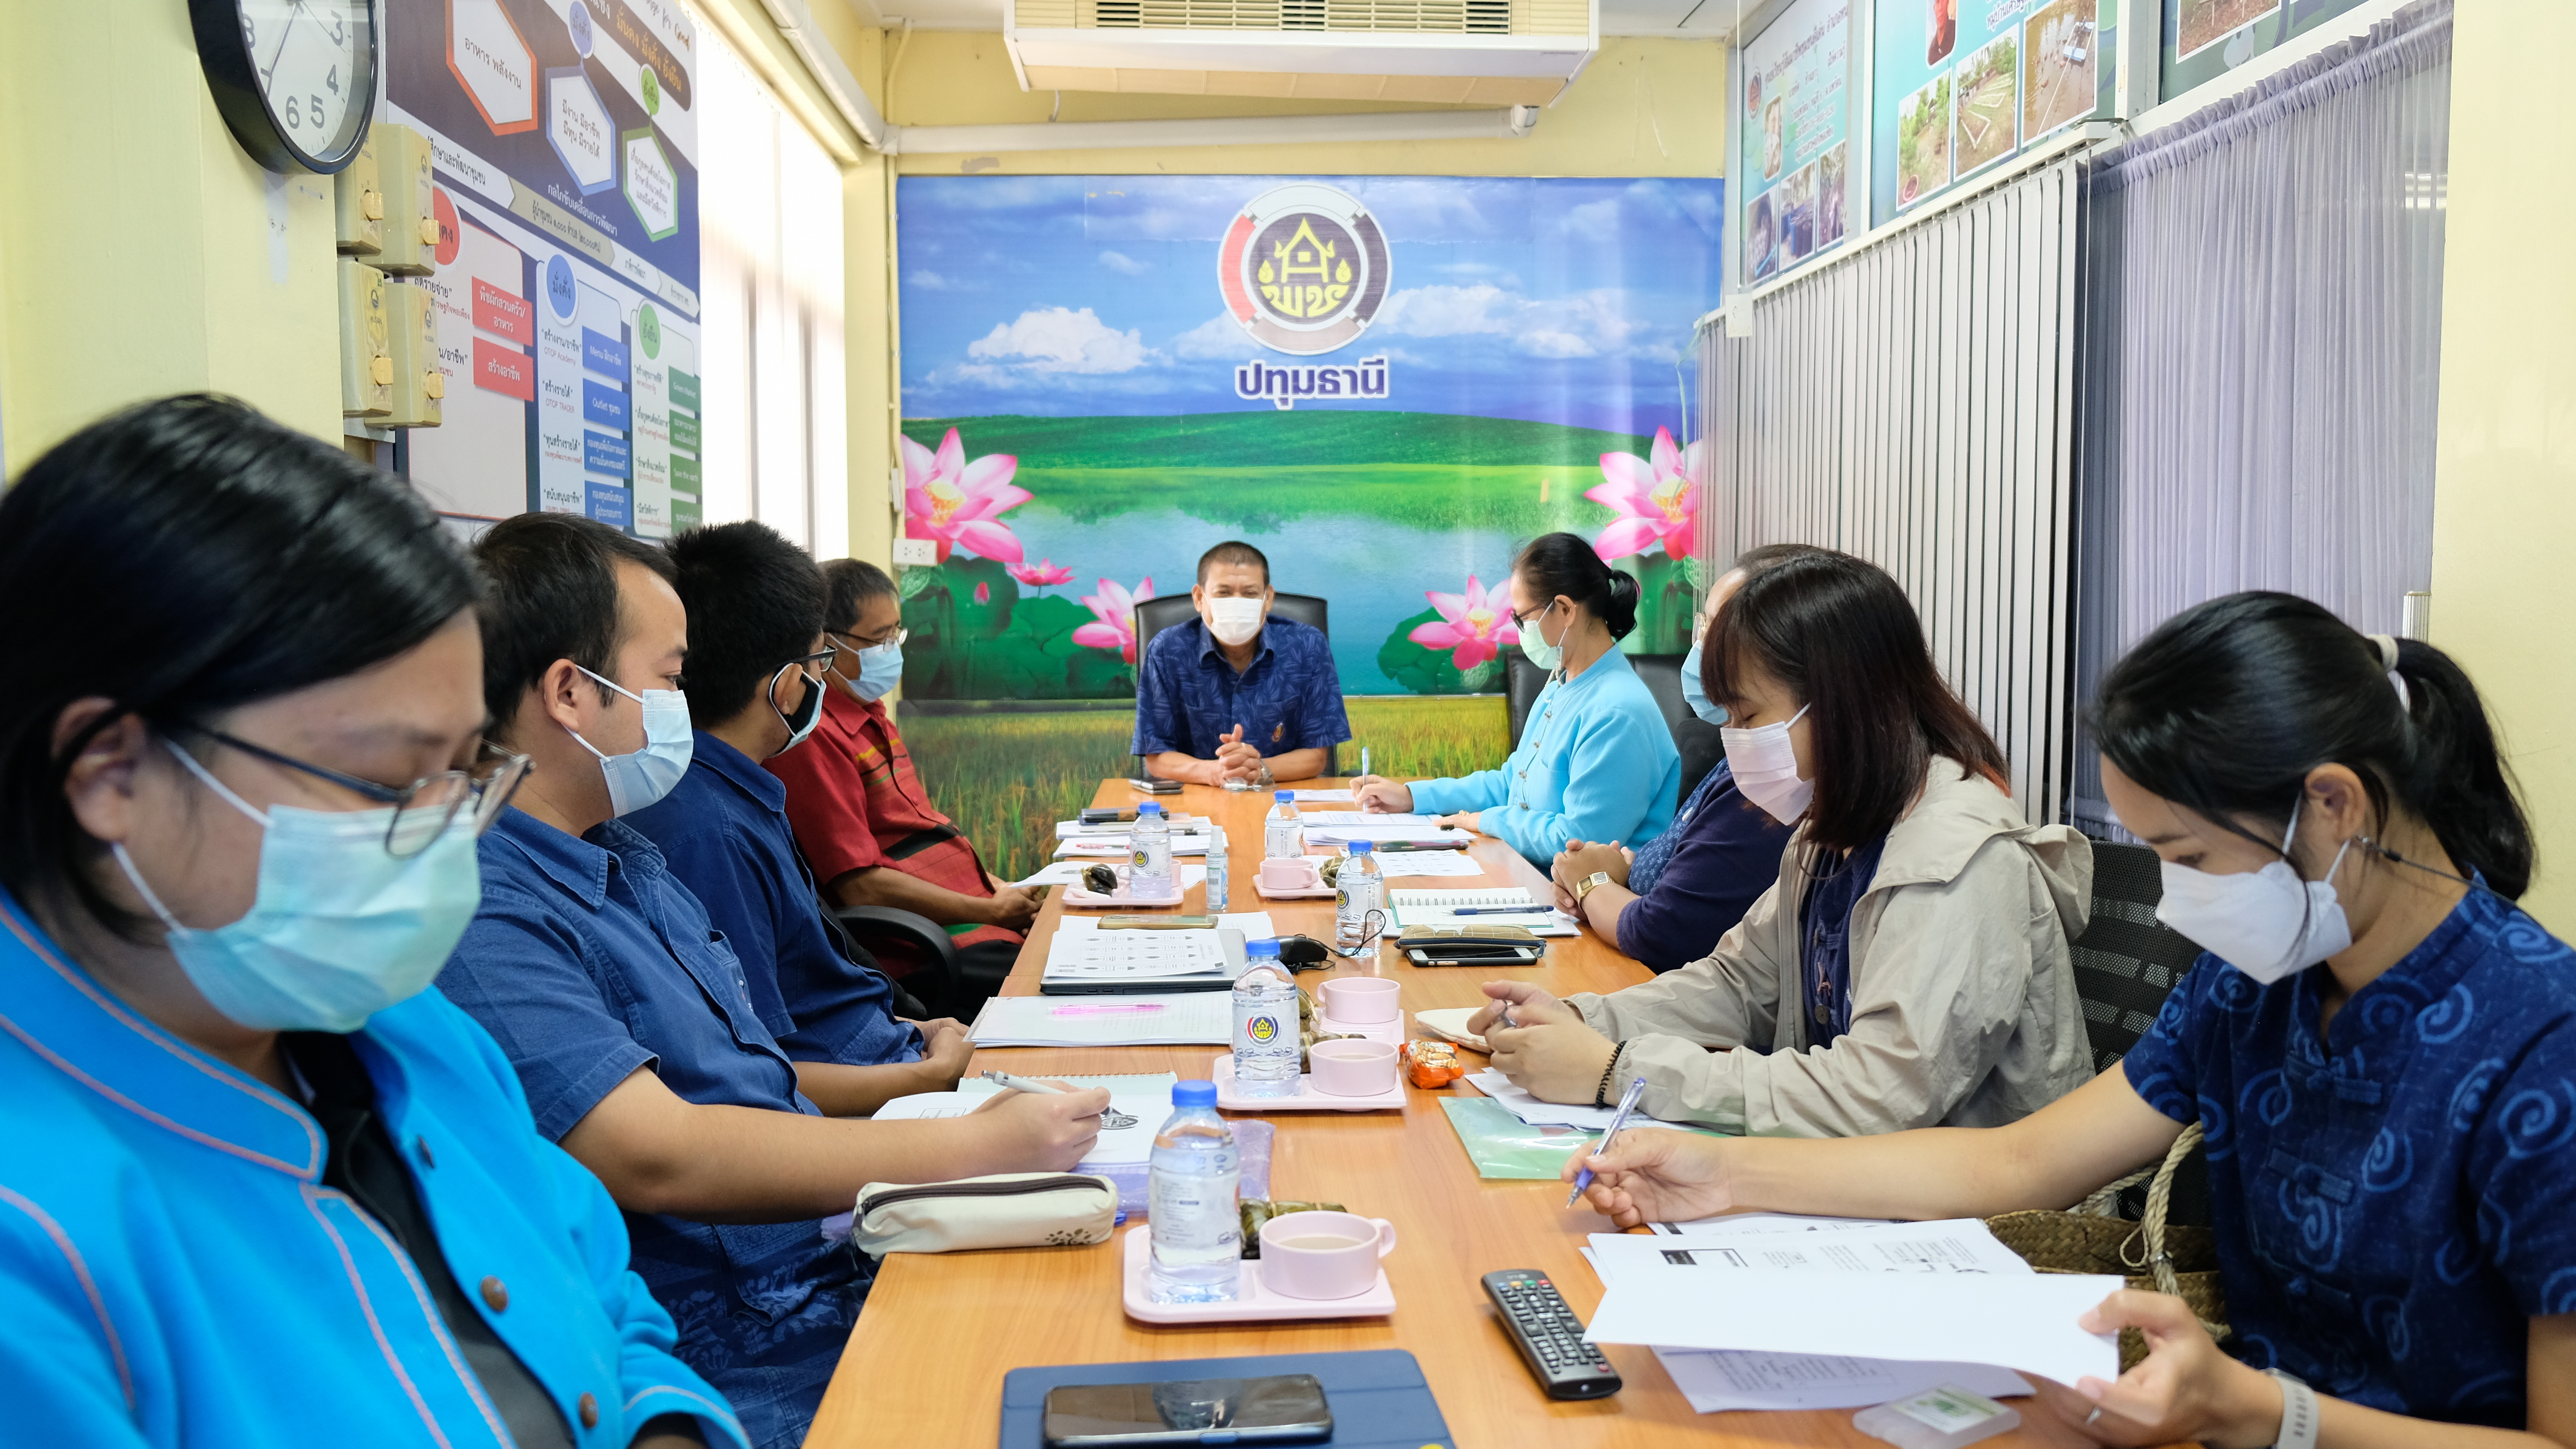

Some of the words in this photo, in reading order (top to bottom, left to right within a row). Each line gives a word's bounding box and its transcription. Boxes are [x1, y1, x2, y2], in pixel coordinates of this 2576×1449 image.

[329, 10, 343, 46] 3
[465, 38, 490, 65] อาหาร
[492, 59, 521, 90] พลังงาน
[616, 6, 639, 48] มั่นคง
[642, 32, 661, 70] มั่งคั่ง
[663, 54, 682, 92] ยั่งยืน
[326, 64, 338, 96] 4
[286, 95, 300, 129] 6
[310, 94, 324, 129] 5
[563, 99, 578, 123] มีงาน
[580, 113, 600, 140] มีอาชีพ
[564, 120, 577, 144] มีทุน
[579, 132, 600, 160] มีรายได้
[548, 183, 617, 236] กลไกขับเคลื่อนการพัฒนา
[441, 225, 453, 244] คง
[553, 271, 571, 300] มั่งคั่ง
[435, 300, 470, 320] รษฐกิจพอเพียง
[479, 286, 525, 318] พืชผักสวนครัว/
[370, 316, 382, 325] HUSAN
[494, 317, 513, 333] อาหาร
[439, 347, 468, 369] น/อาชีพ”
[544, 347, 556, 357] OTOP
[590, 346, 603, 359] Menu
[488, 358, 520, 381] สร้างอาชีพ
[1239, 358, 1386, 407] ปทุมธานี
[545, 398, 558, 408] OTOP
[559, 402, 574, 413] TRADER
[593, 398, 608, 411] Outlet
